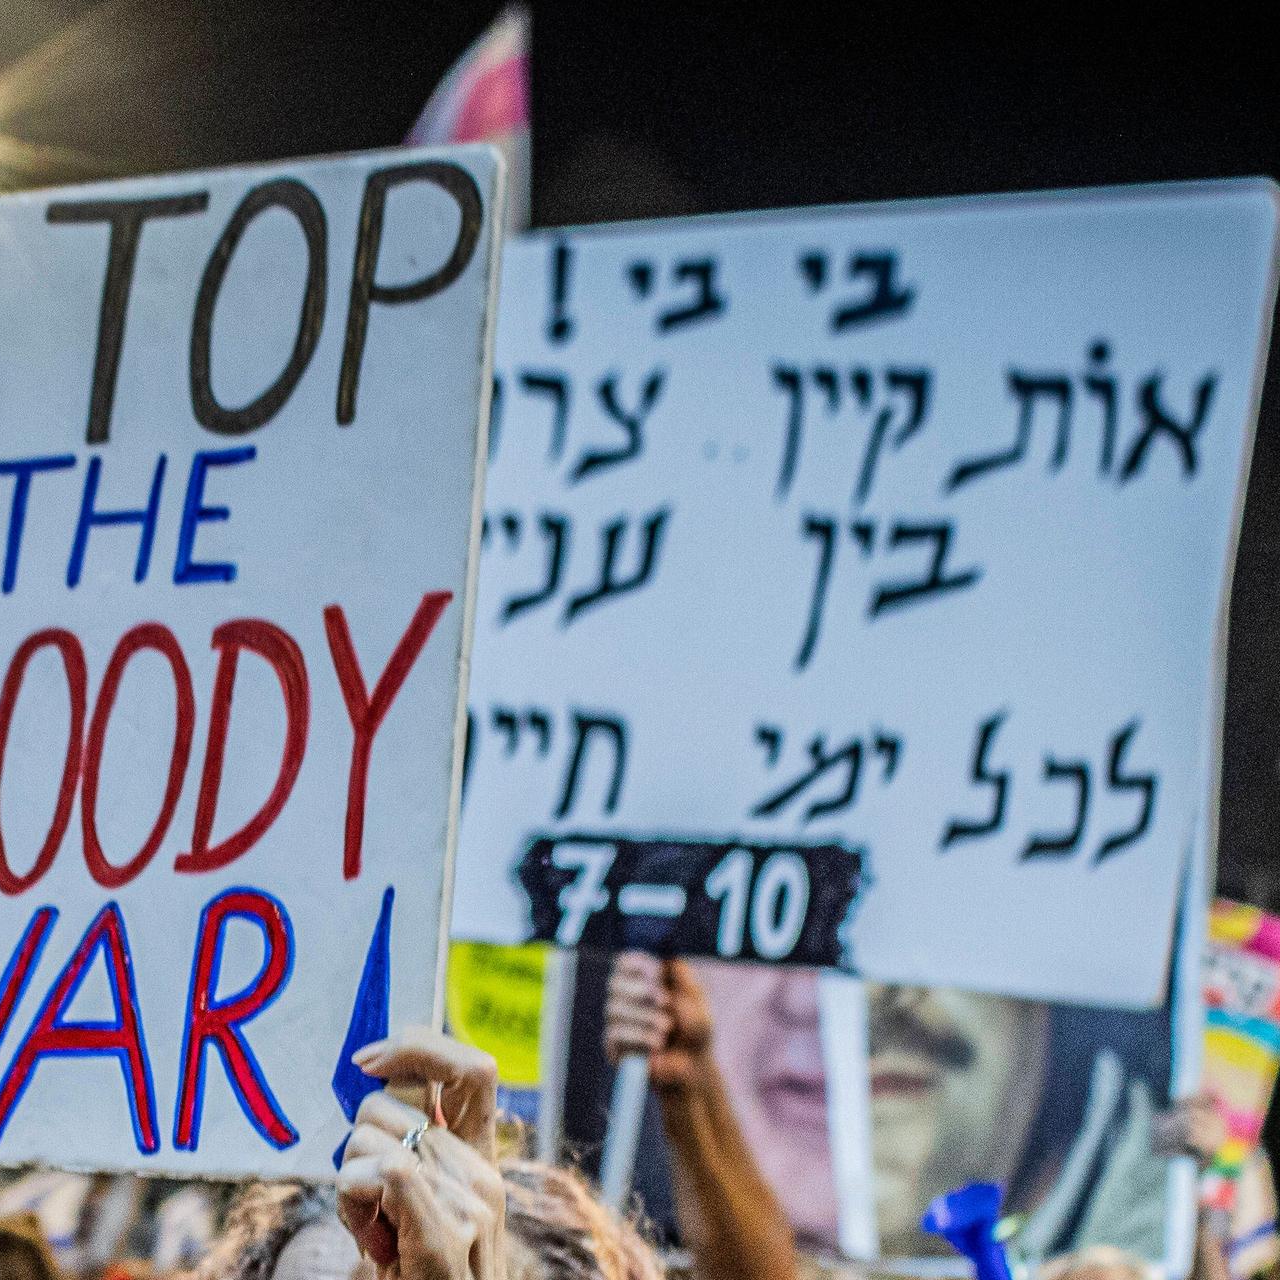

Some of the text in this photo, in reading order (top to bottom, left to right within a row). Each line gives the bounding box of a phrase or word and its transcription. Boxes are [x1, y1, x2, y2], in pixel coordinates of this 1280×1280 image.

[797, 247, 917, 332] בי
[771, 358, 935, 503] קיין
[800, 508, 985, 675] בין
[749, 722, 906, 826] ימי
[935, 700, 1160, 866] לכל
